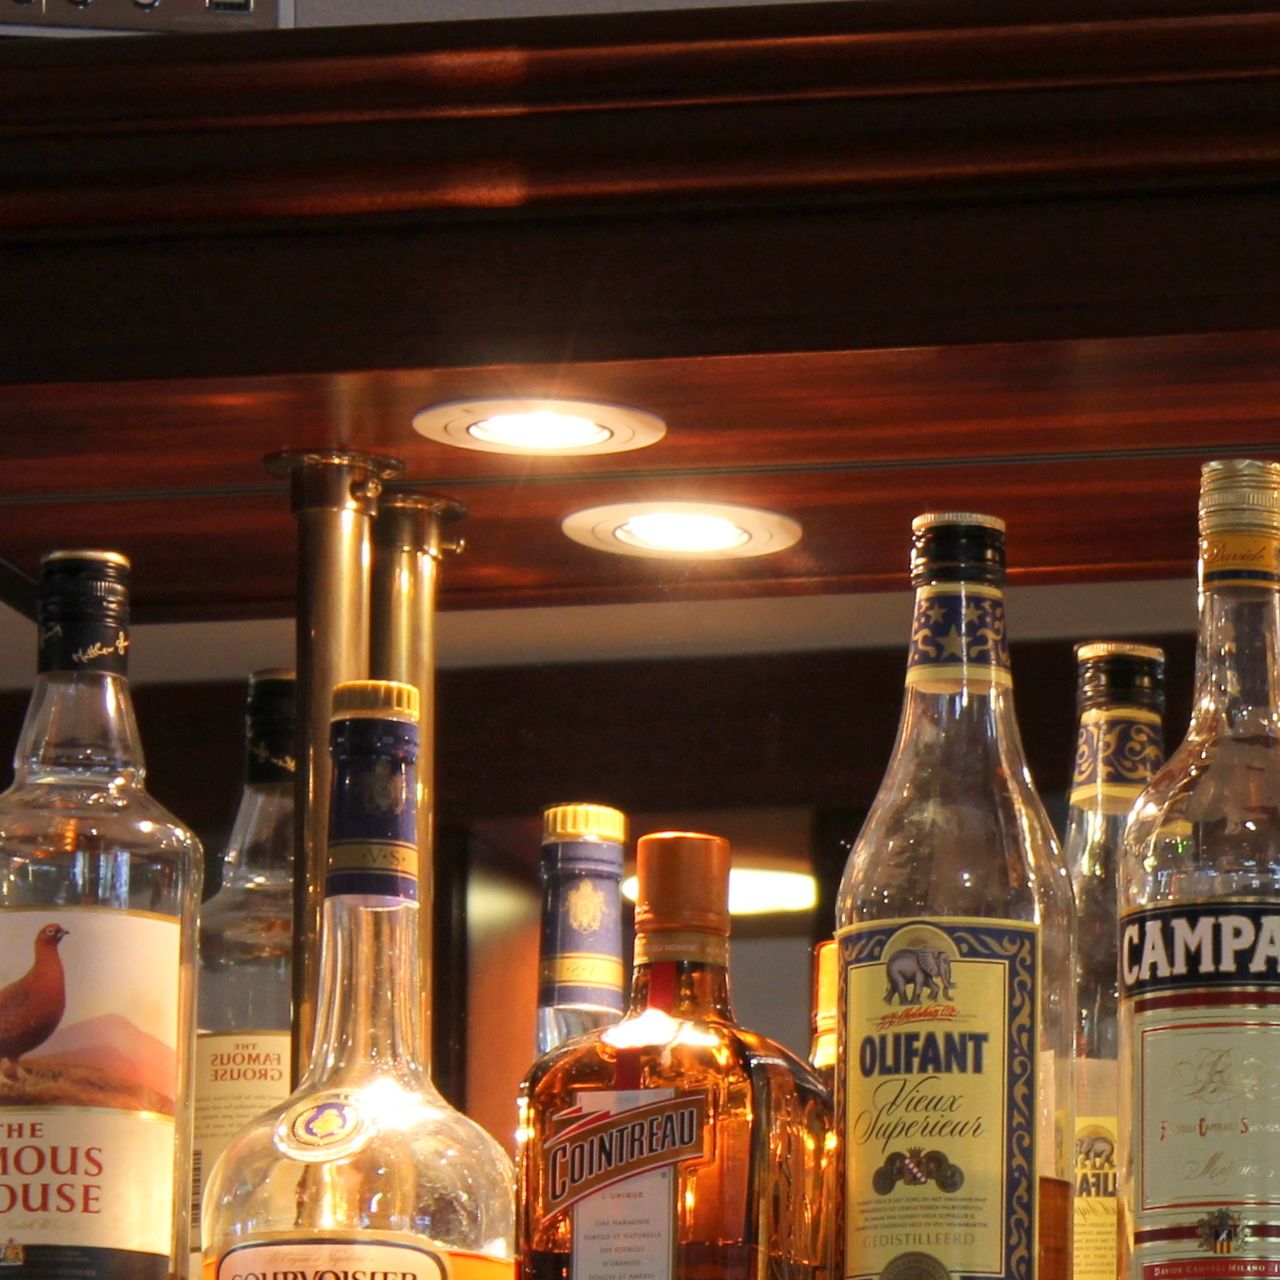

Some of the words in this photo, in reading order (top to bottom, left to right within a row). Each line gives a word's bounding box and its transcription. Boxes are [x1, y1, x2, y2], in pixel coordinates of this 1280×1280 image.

[859, 1031, 990, 1078] OLIFANT
[872, 1076, 965, 1117] Vieux
[550, 1108, 698, 1202] COINTREAU
[1229, 1263, 1266, 1273] MILANO
